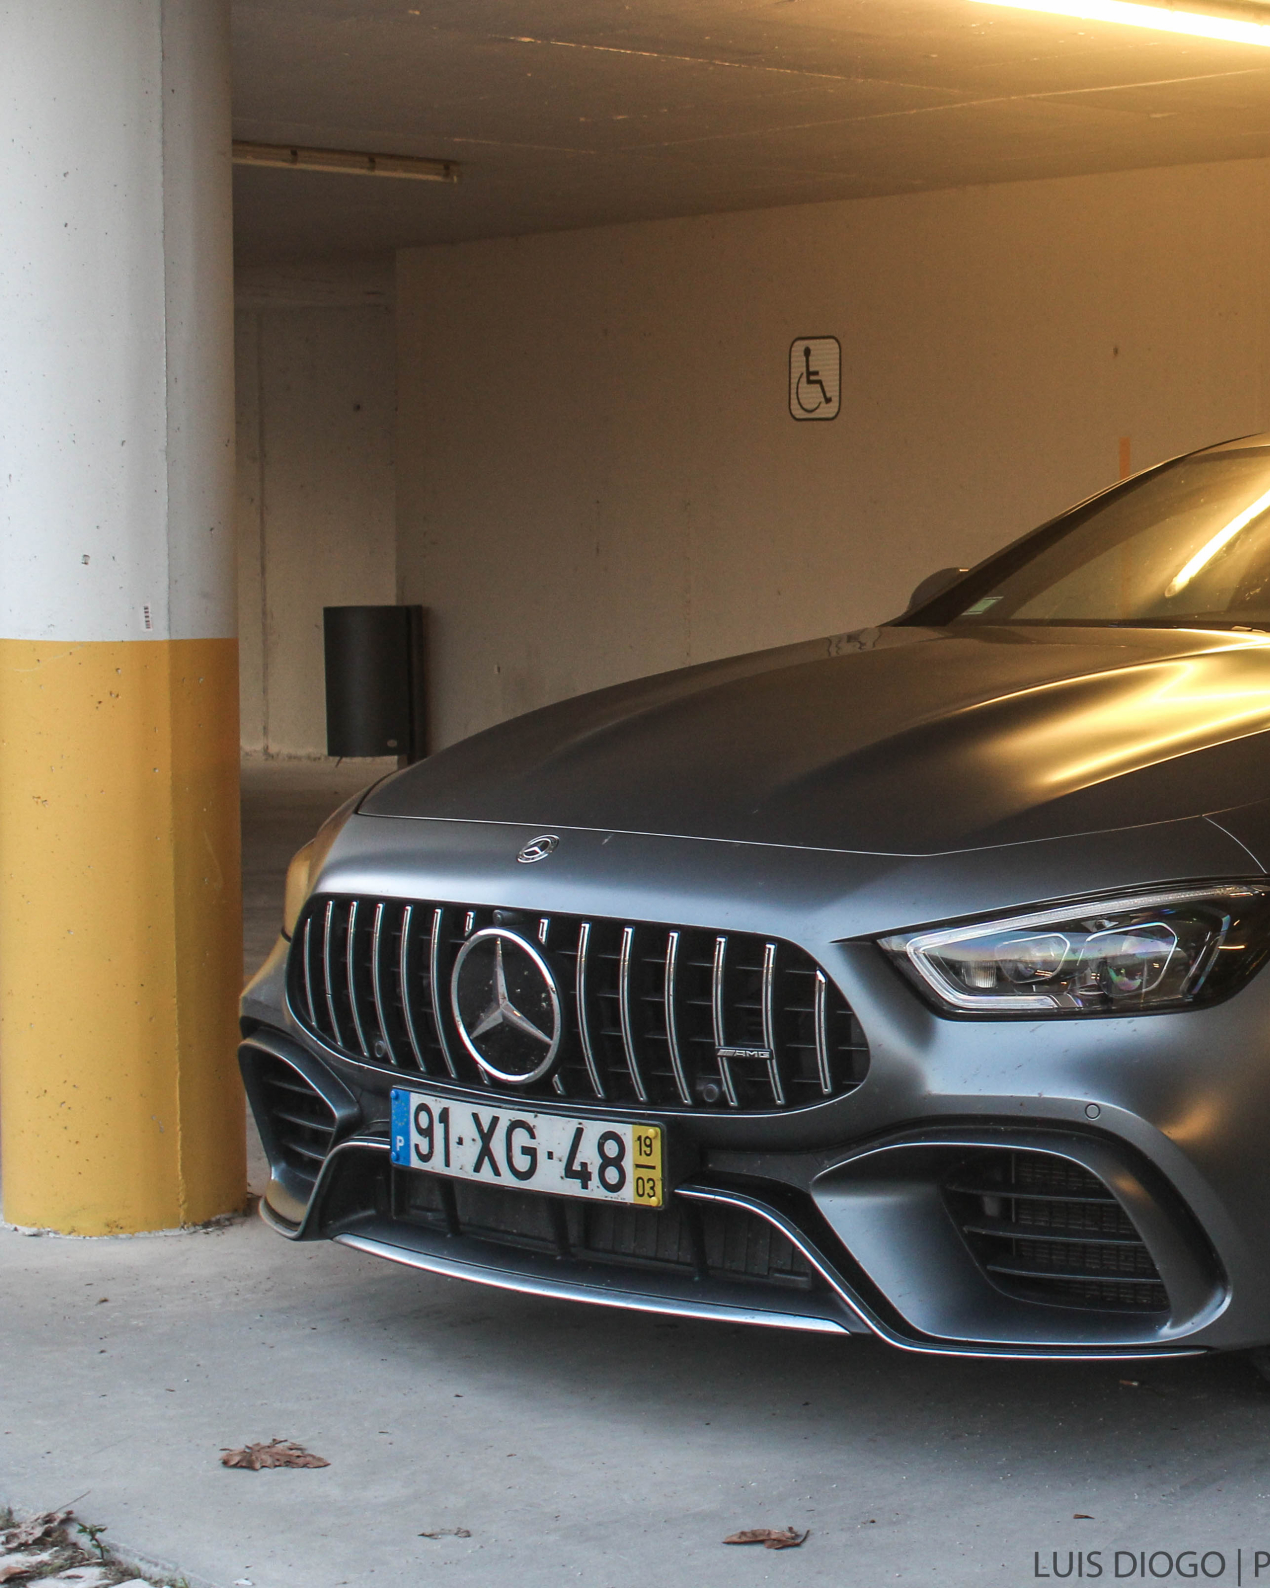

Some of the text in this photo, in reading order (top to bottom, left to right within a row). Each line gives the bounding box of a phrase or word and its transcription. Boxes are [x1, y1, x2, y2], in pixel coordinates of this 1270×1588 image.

[734, 1049, 770, 1058] AMG
[396, 1136, 405, 1151] P
[636, 1134, 653, 1157] 19
[635, 1176, 657, 1199] 03
